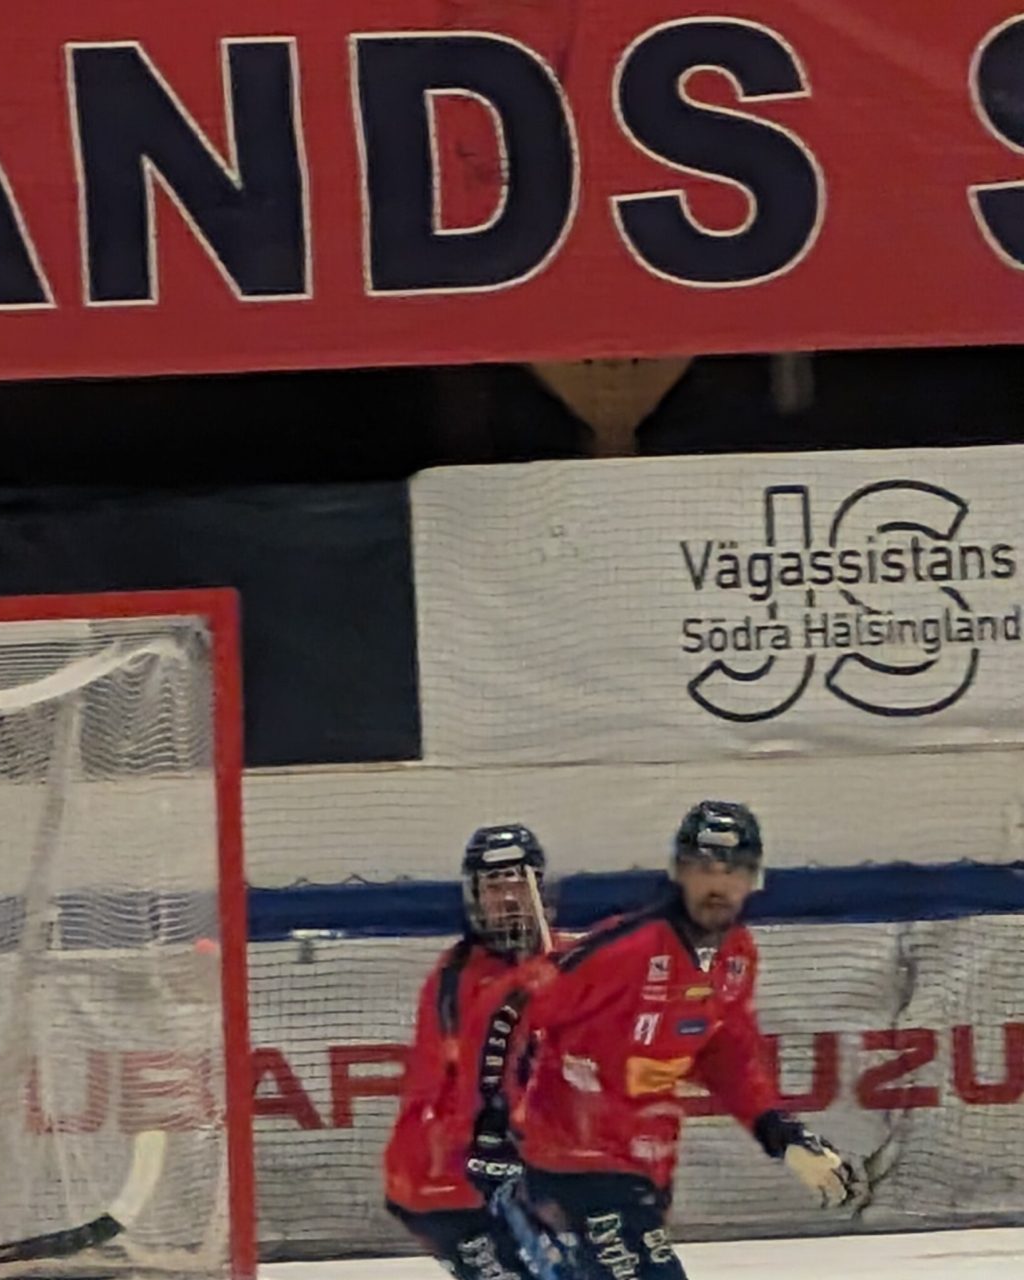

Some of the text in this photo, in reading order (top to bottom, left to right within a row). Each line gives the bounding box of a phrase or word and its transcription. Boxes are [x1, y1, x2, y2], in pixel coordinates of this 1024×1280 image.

[679, 536, 1018, 602] Vägassistans
[682, 604, 1023, 656] Södra Hälsingland
